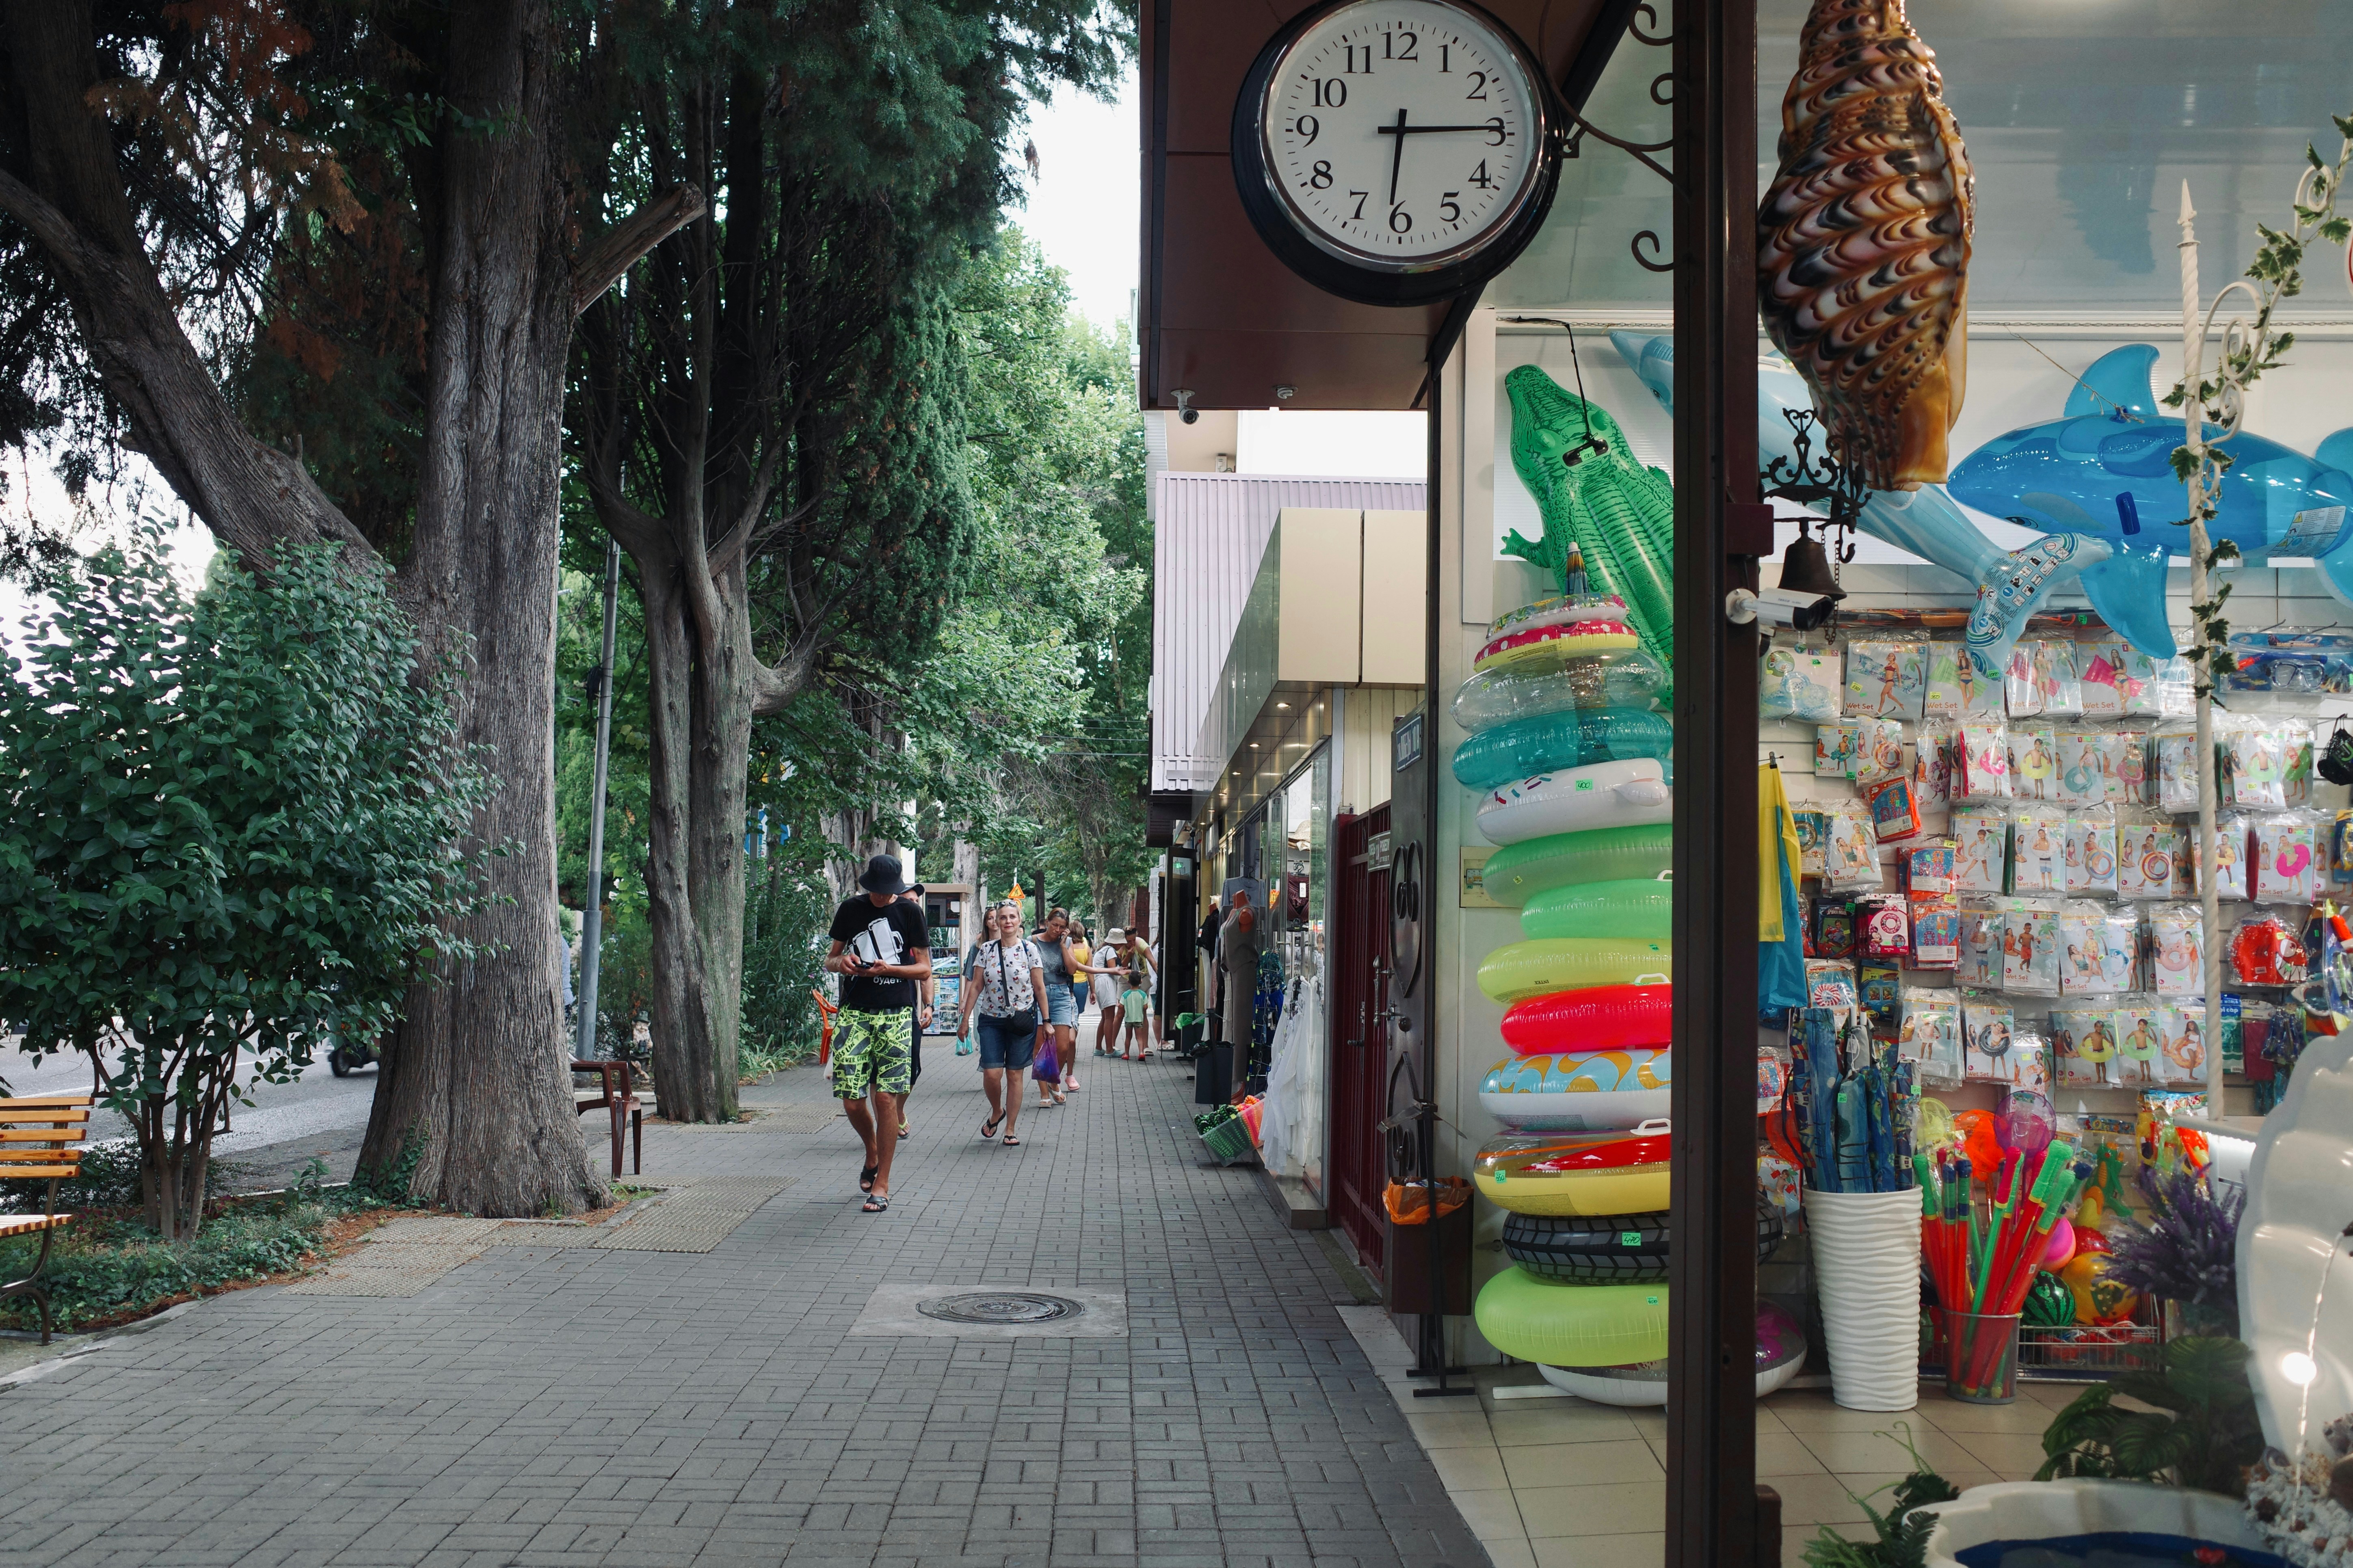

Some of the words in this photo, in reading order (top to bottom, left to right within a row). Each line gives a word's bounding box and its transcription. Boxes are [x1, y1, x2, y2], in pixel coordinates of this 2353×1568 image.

[1343, 45, 1374, 74] 11
[1382, 32, 1418, 62] 12
[1438, 44, 1452, 73] 1
[1312, 78, 1347, 108] 10
[1466, 72, 1487, 101] 2
[1297, 115, 1319, 148] 9
[1485, 117, 1506, 147] 3
[1311, 161, 1334, 190] 8
[1469, 159, 1492, 189] 4
[1350, 191, 1369, 220] 7
[1389, 201, 1412, 234] 6
[1440, 191, 1460, 222] 5
[2029, 593, 2041, 605] INTEX
[896, 1030, 910, 1040] GIVE
[885, 1062, 897, 1070] MEN
